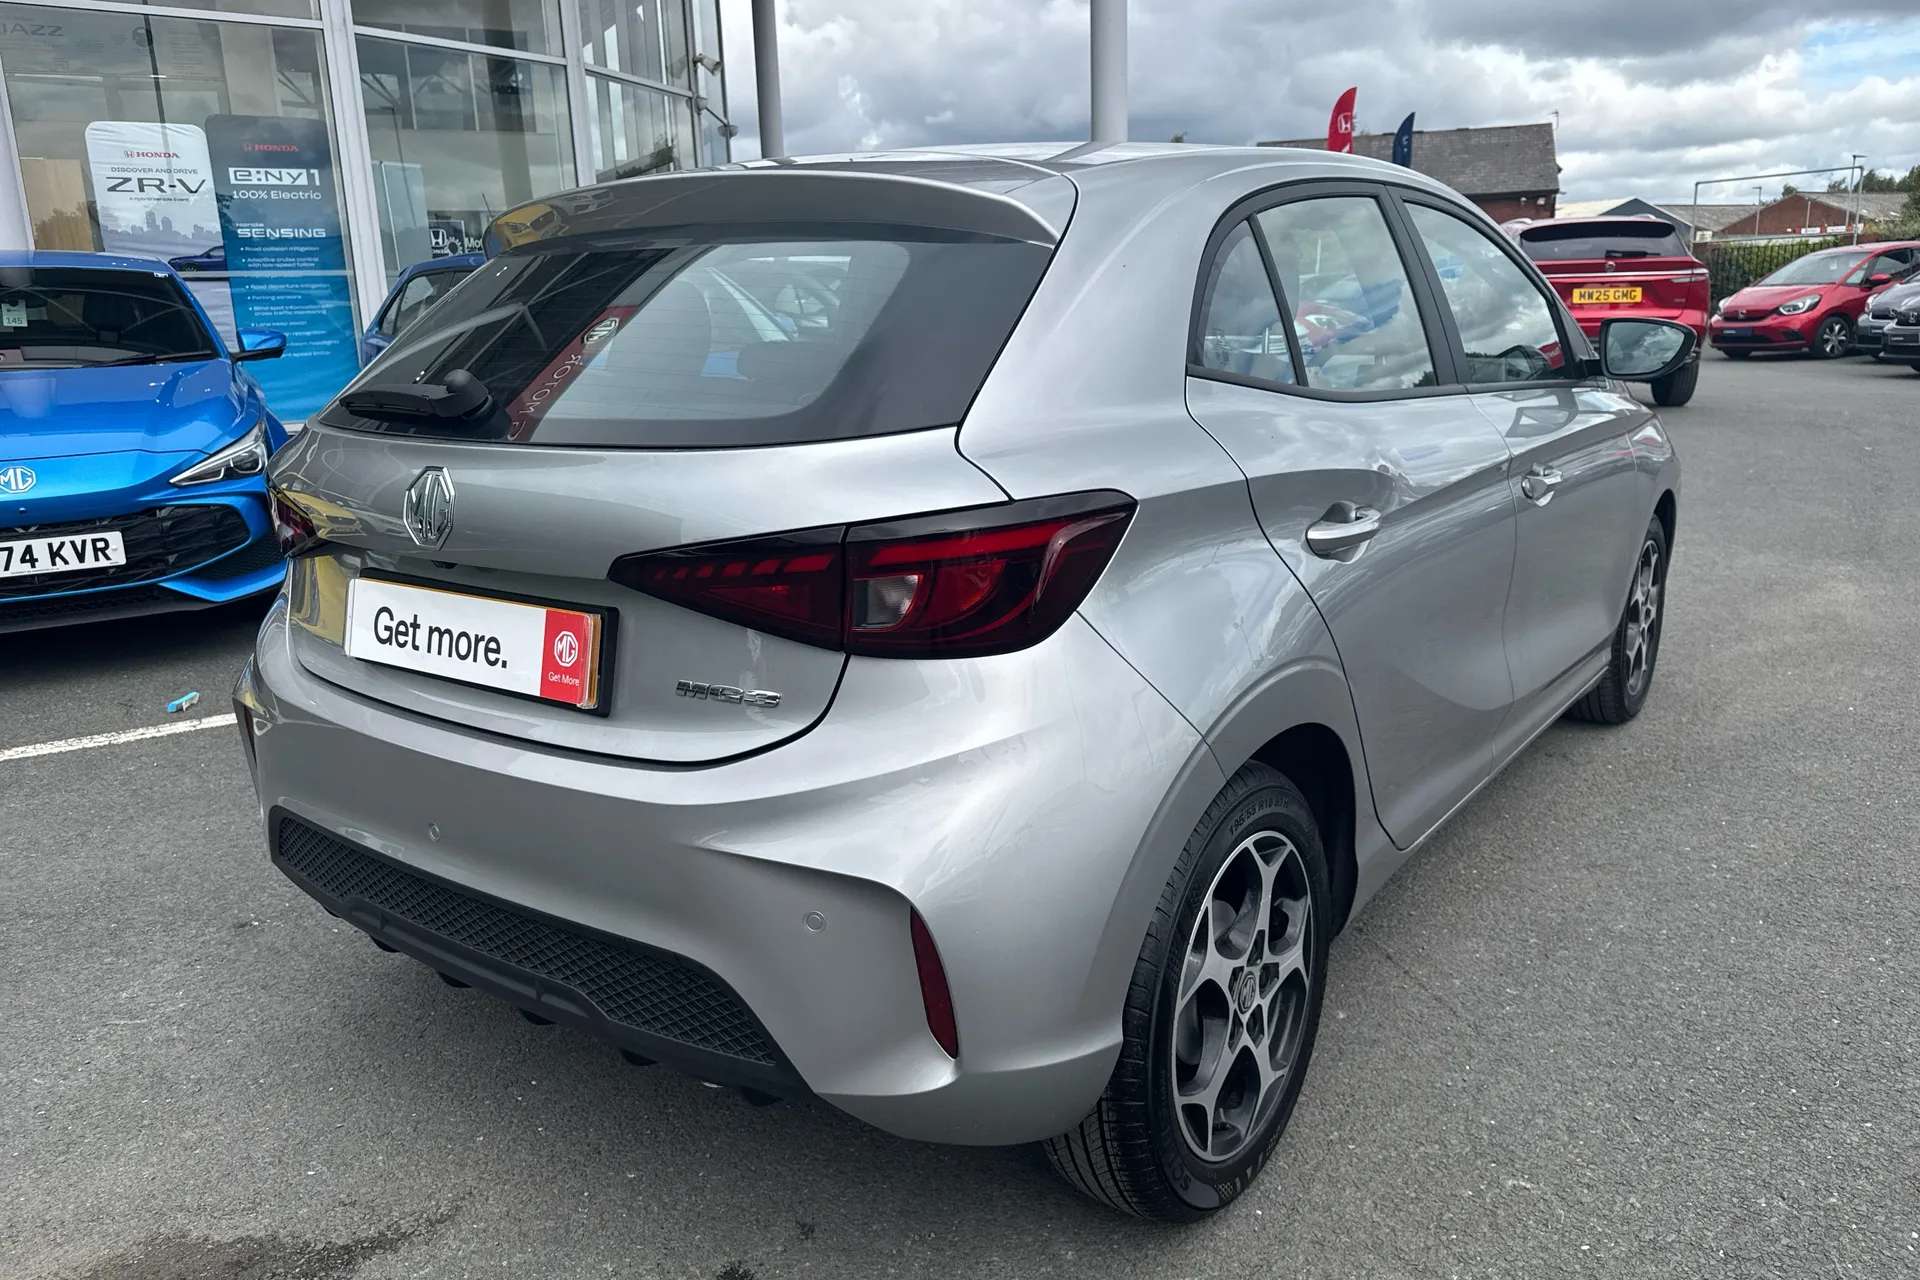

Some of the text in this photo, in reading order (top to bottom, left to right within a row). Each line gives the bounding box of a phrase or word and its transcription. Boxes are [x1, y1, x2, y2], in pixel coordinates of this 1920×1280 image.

[136, 151, 180, 159] HONDA
[254, 144, 299, 152] HONDA
[106, 176, 206, 194] ZR-V
[232, 190, 322, 200] 100% Electric
[237, 228, 327, 238] SENSING
[1613, 289, 1638, 300] GMG
[0, 468, 34, 491] MG
[47, 537, 112, 567] KVR
[373, 606, 508, 668] Get more.
[556, 634, 577, 664] MG
[548, 671, 580, 687] Get More
